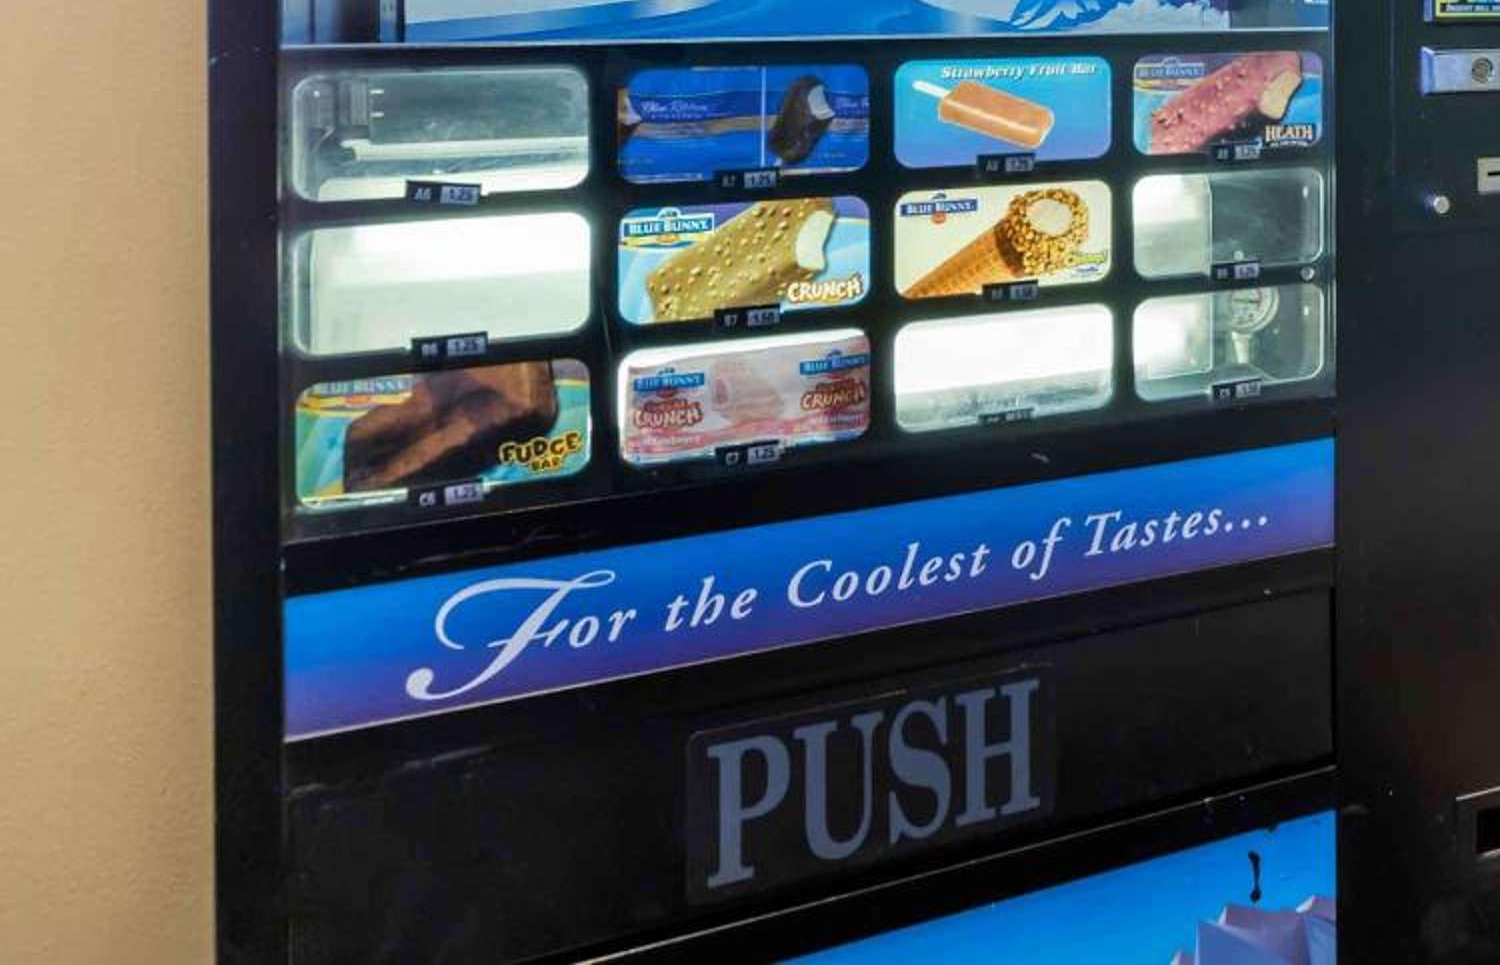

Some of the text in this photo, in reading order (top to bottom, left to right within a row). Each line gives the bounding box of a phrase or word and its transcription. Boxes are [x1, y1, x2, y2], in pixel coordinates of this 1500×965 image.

[940, 62, 1098, 80] Strawberry Fruit Bar
[1265, 124, 1314, 142] HEATH
[906, 201, 933, 214] BLUE
[628, 218, 709, 235] BLUE BUNNY
[787, 275, 862, 302] CRUNCH
[801, 384, 866, 410] CRUNCH
[634, 407, 702, 427] CRUNCH
[499, 431, 581, 464] FUDGE
[753, 447, 775, 460] 1.25
[531, 456, 561, 472] BAR
[404, 505, 1269, 701] For the Coolest of Tastes...
[706, 677, 1041, 890] PUSH
